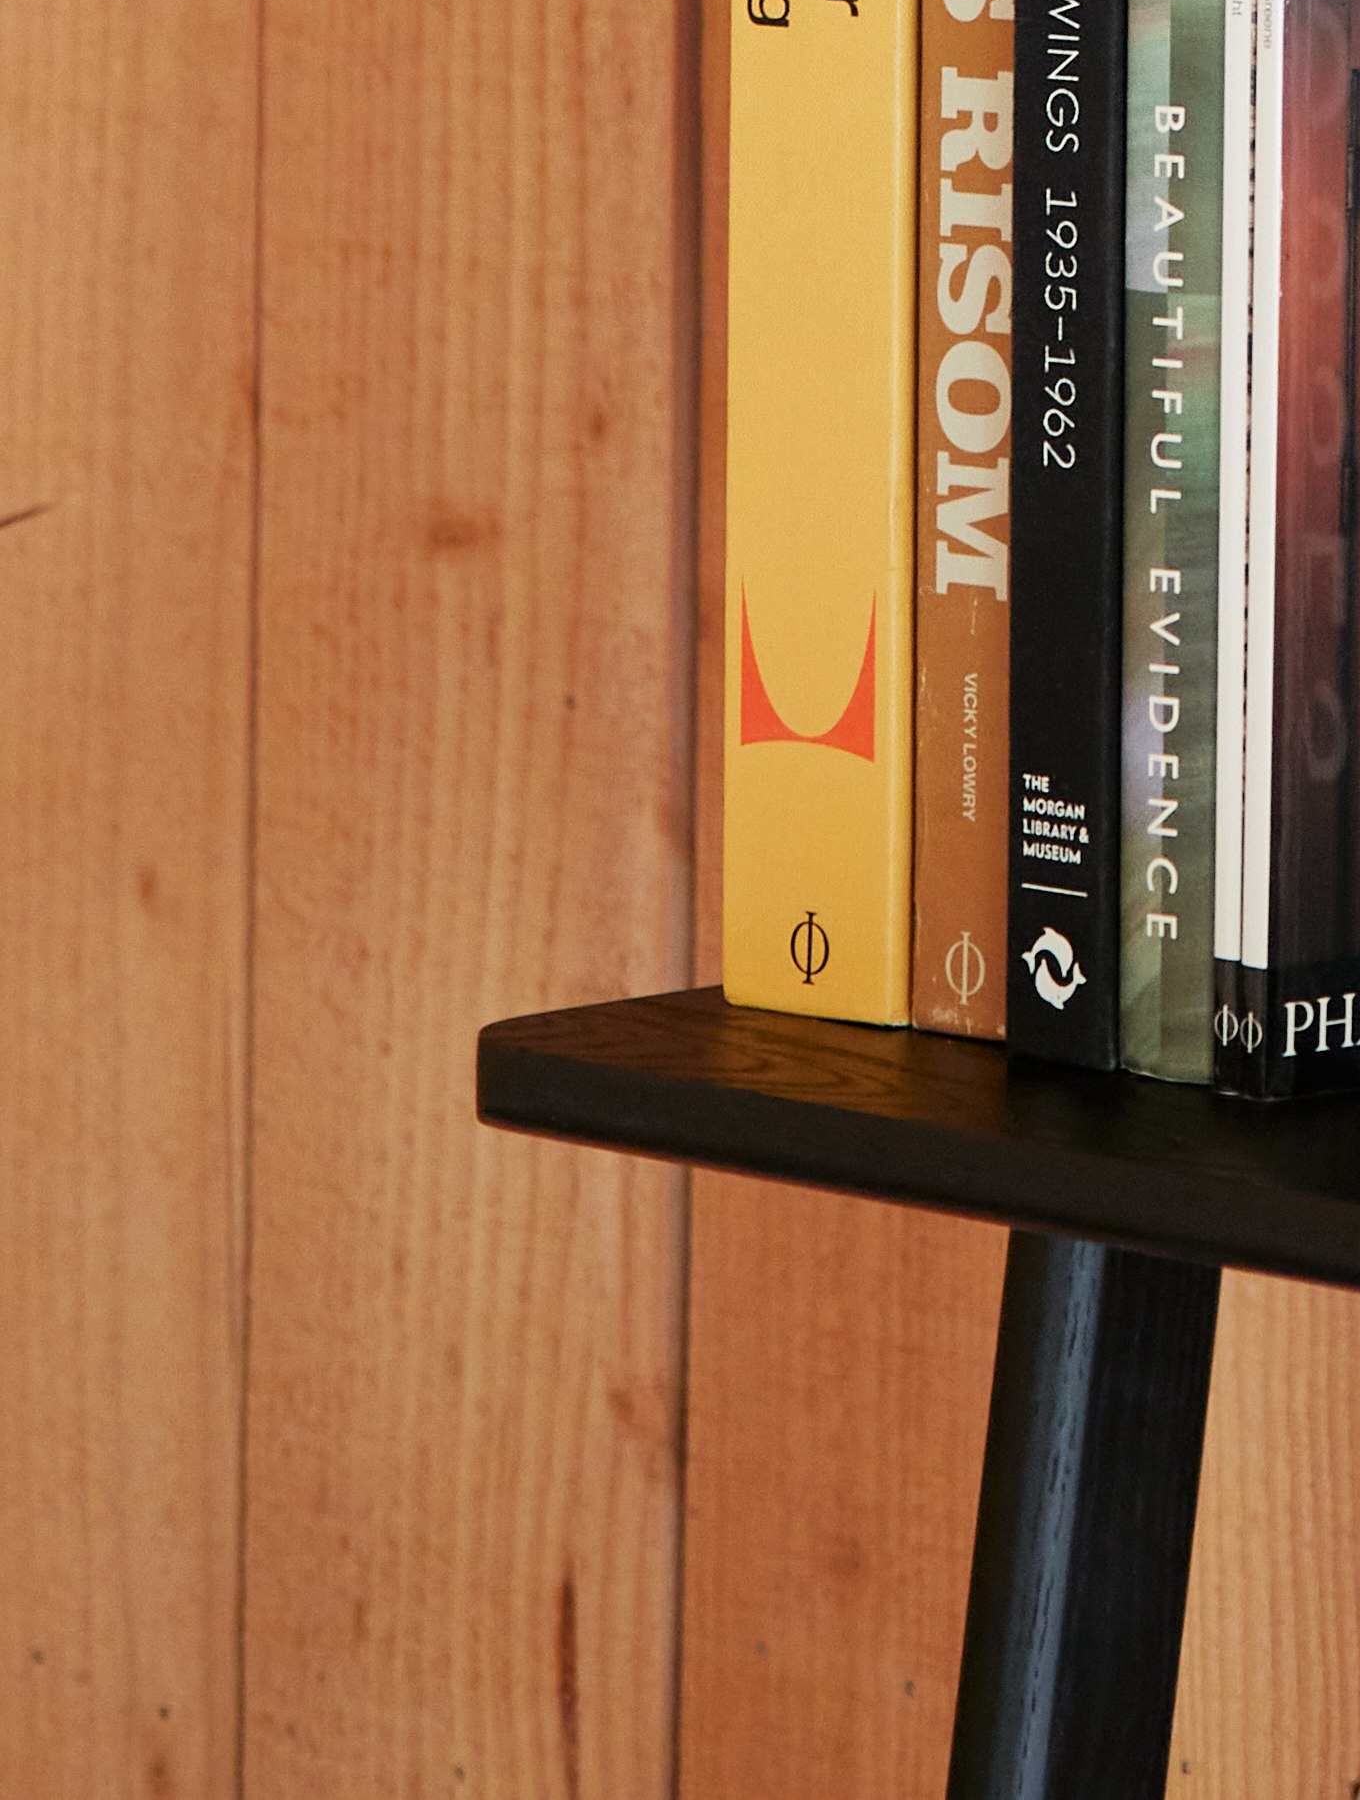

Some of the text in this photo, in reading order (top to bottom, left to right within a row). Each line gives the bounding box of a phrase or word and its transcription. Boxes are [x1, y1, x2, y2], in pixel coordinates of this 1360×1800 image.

[935, 67, 1014, 600] RISOM
[1145, 105, 1186, 941] BEAUTIFUL EVIDENCE
[960, 672, 980, 823] VICKY LOWRY
[1023, 773, 1049, 793] THE
[1023, 797, 1085, 819] MORGAN
[1023, 818, 1089, 843] LIBRARY &
[1023, 840, 1081, 864] MUSEUM
